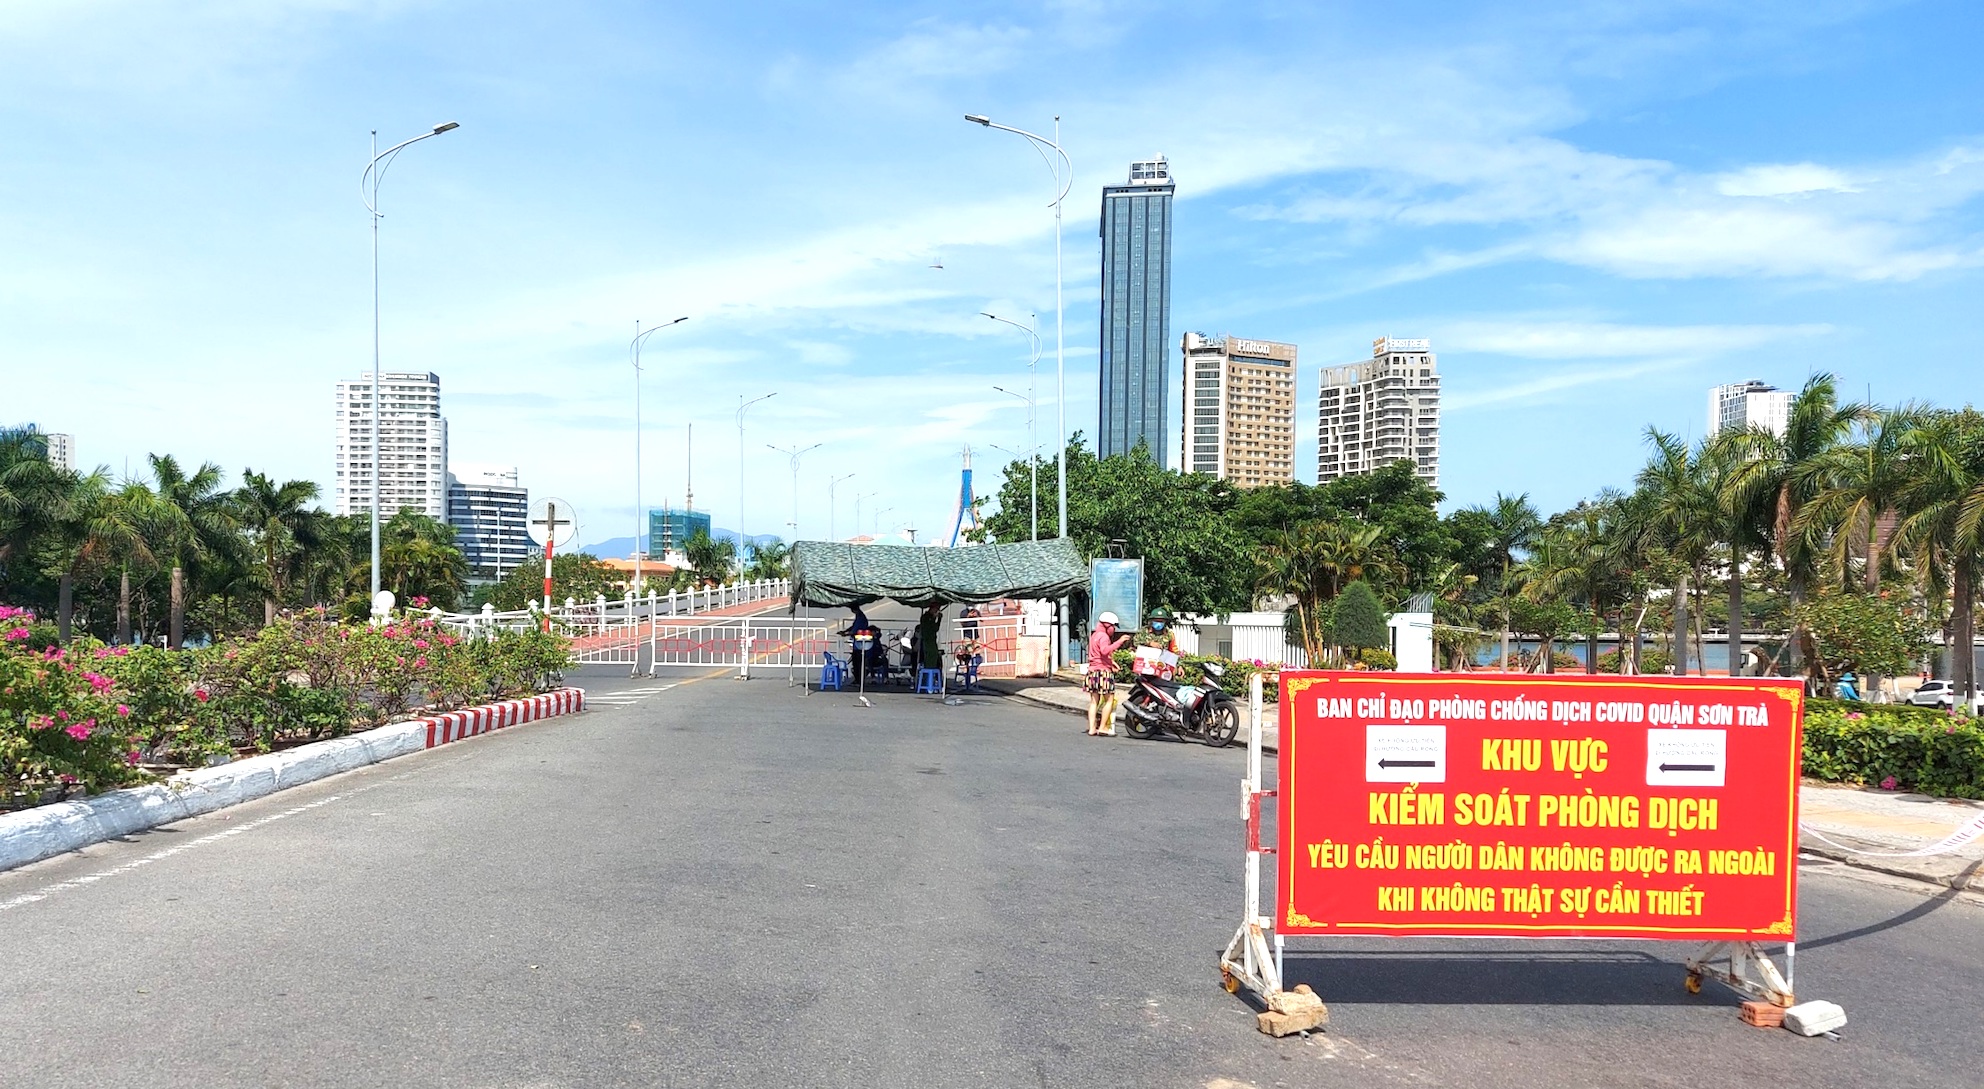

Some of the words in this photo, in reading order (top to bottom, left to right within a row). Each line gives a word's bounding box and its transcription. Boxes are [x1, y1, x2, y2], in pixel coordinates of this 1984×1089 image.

[1237, 339, 1270, 354] Hilton
[1317, 697, 1353, 719] BAN
[1357, 691, 1386, 719] CHỈ
[1390, 698, 1425, 724] ĐẠO
[1429, 693, 1487, 720] PHÒNG
[1491, 693, 1548, 721] CHỐNG
[1552, 700, 1592, 726] DỊCH
[1596, 702, 1645, 723] COVID
[1648, 700, 1695, 729] QUẬN
[1698, 704, 1733, 726] SƠN
[1737, 702, 1769, 727] TRÀ
[1482, 738, 1542, 771] KHU
[1551, 737, 1609, 780] VỰC
[1370, 782, 1445, 825] KIỂM
[1454, 787, 1531, 827] SOÁT
[1539, 787, 1640, 829] PHÒNG
[1649, 797, 1718, 837] DỊCH
[1308, 838, 1349, 869] YÊU
[1356, 835, 1400, 870] CẦU
[1406, 838, 1473, 870] NGƯỜI
[1479, 840, 1525, 871] DÂN
[1531, 841, 1605, 872] KHÔNG
[1610, 845, 1669, 879] ĐƯỢC
[1674, 849, 1703, 875] RA
[1709, 845, 1775, 876] NGOÀI
[1378, 886, 1415, 912] KHI
[1421, 881, 1496, 912] KHÔNG
[1501, 883, 1555, 919] THẬT
[1560, 887, 1592, 919] SỰ
[1595, 880, 1641, 914] CẦN
[1646, 883, 1705, 916] THIẾT
